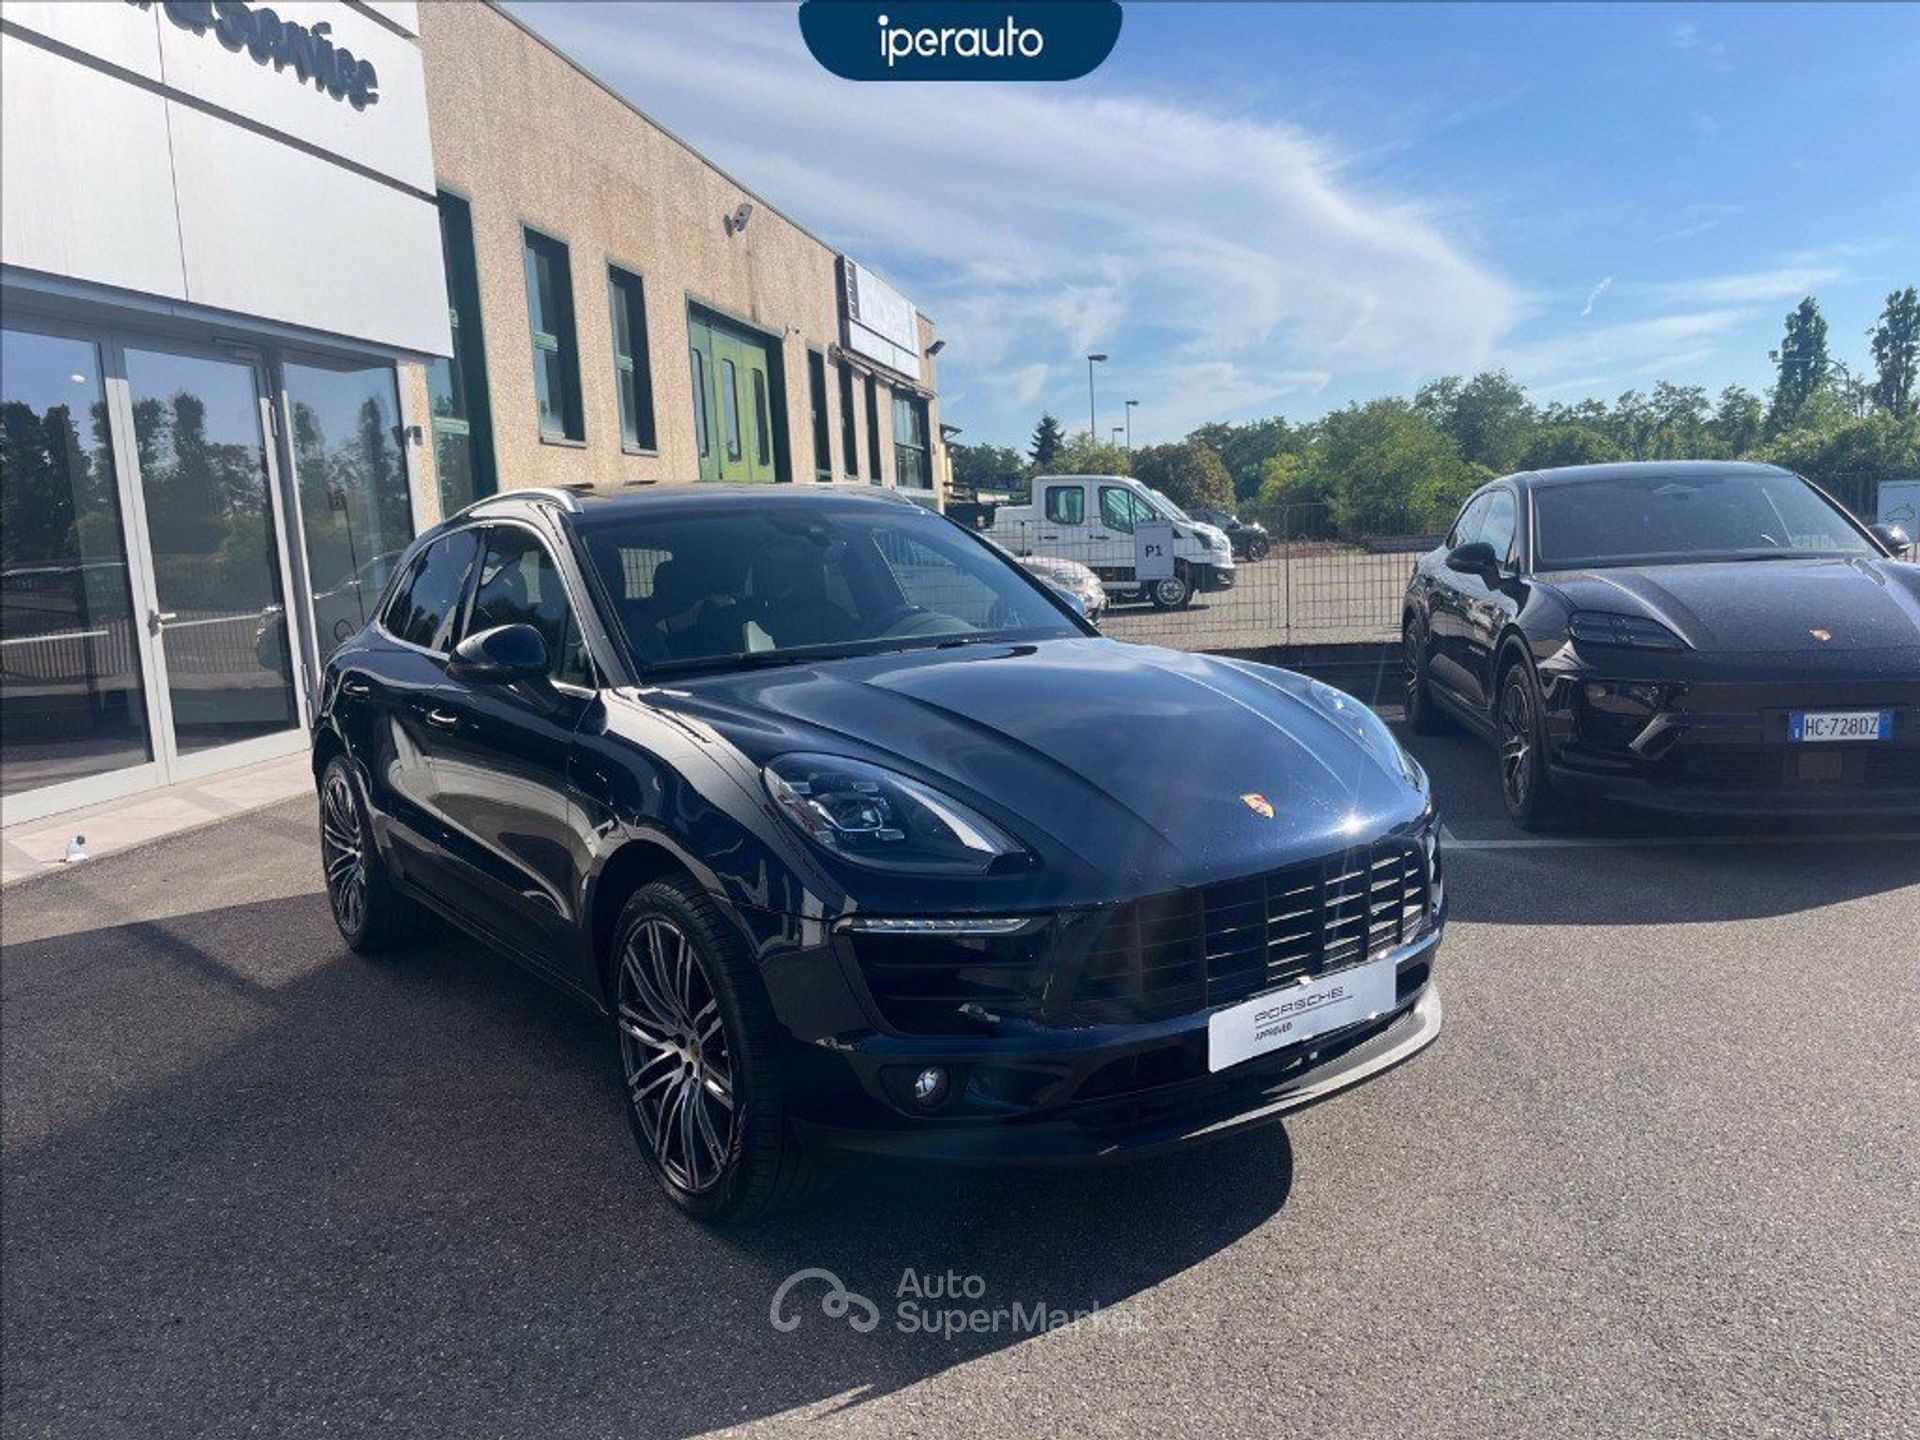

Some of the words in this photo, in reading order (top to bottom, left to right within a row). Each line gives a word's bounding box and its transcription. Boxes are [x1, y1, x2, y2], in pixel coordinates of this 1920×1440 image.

[1145, 544, 1163, 558] P1
[1254, 986, 1344, 1022] PORSCHE
[1254, 1021, 1293, 1041] APPROVED
